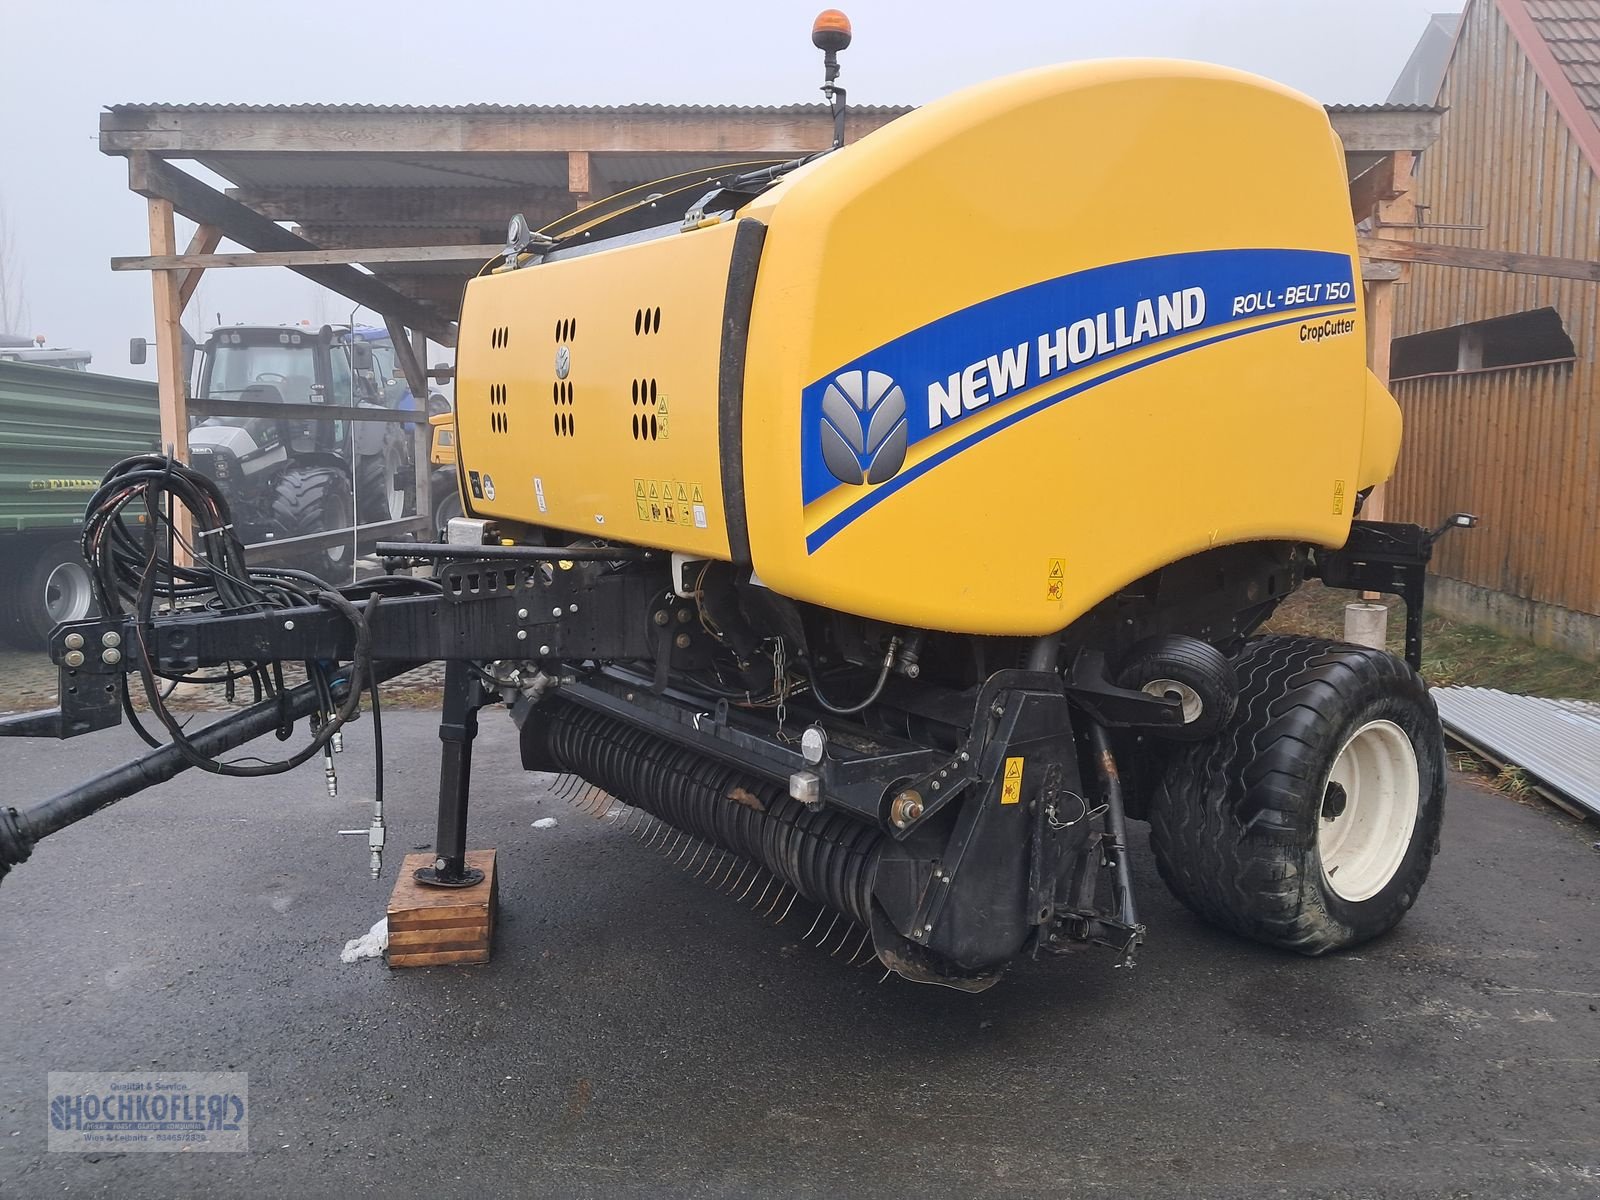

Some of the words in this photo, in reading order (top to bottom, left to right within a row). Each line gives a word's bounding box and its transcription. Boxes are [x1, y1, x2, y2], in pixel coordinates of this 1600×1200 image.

[1232, 283, 1323, 318] ROLL-BELT
[1325, 281, 1351, 301] 150
[1299, 319, 1355, 342] CropCutter
[927, 341, 1029, 429] NEW
[1037, 286, 1206, 377] HOLLAND
